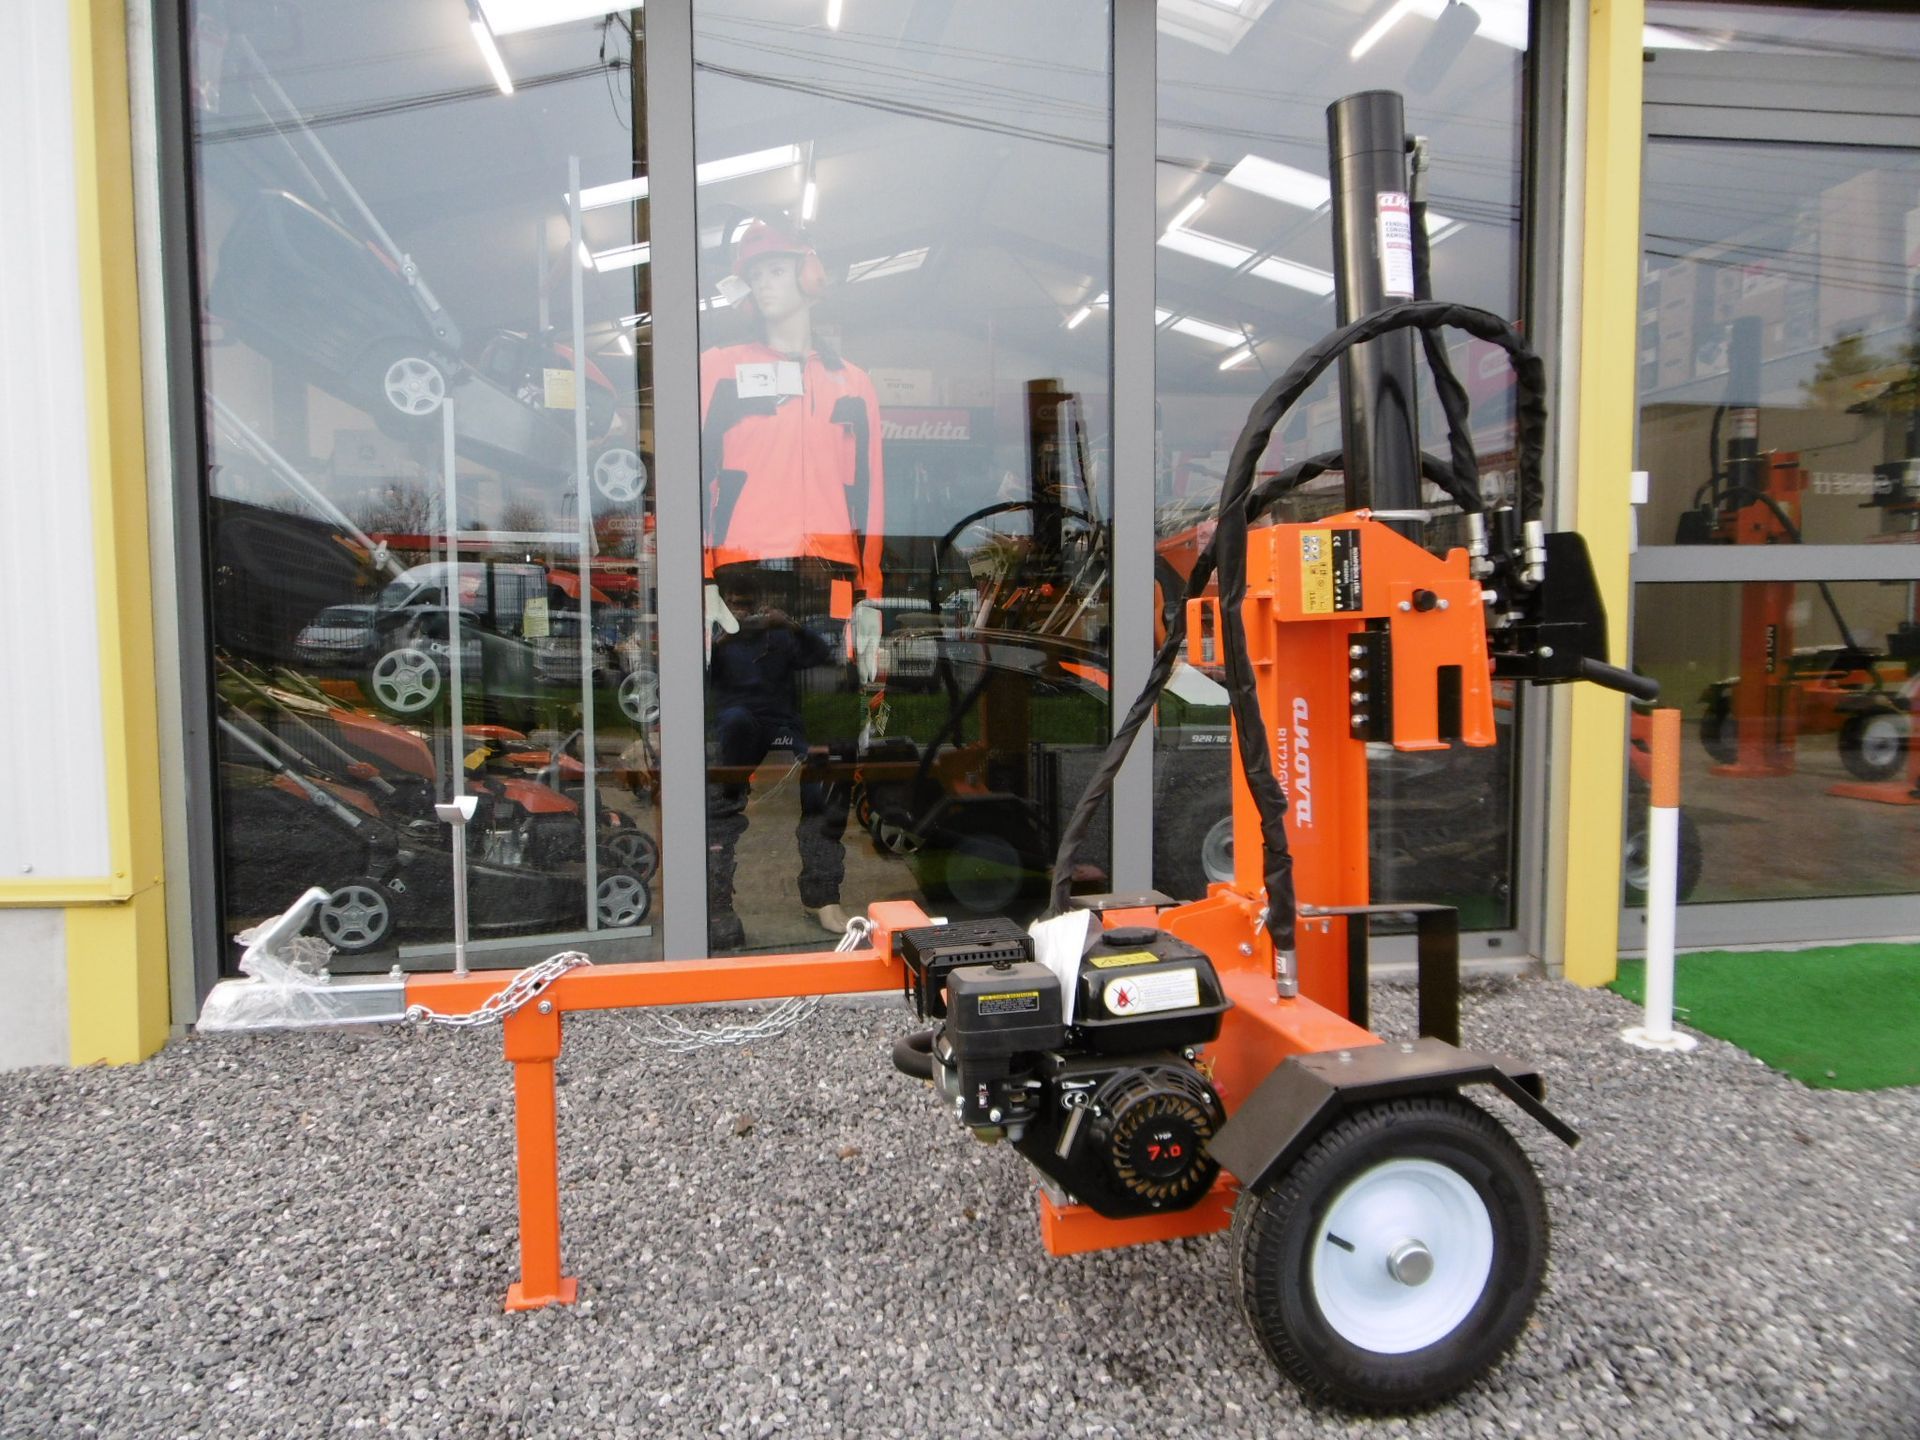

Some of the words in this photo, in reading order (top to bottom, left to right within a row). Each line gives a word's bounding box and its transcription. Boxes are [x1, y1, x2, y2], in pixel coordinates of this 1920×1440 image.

[881, 421, 969, 440] Makita
[1292, 697, 1312, 828] anova
[1147, 1143, 1182, 1161] 7.0
